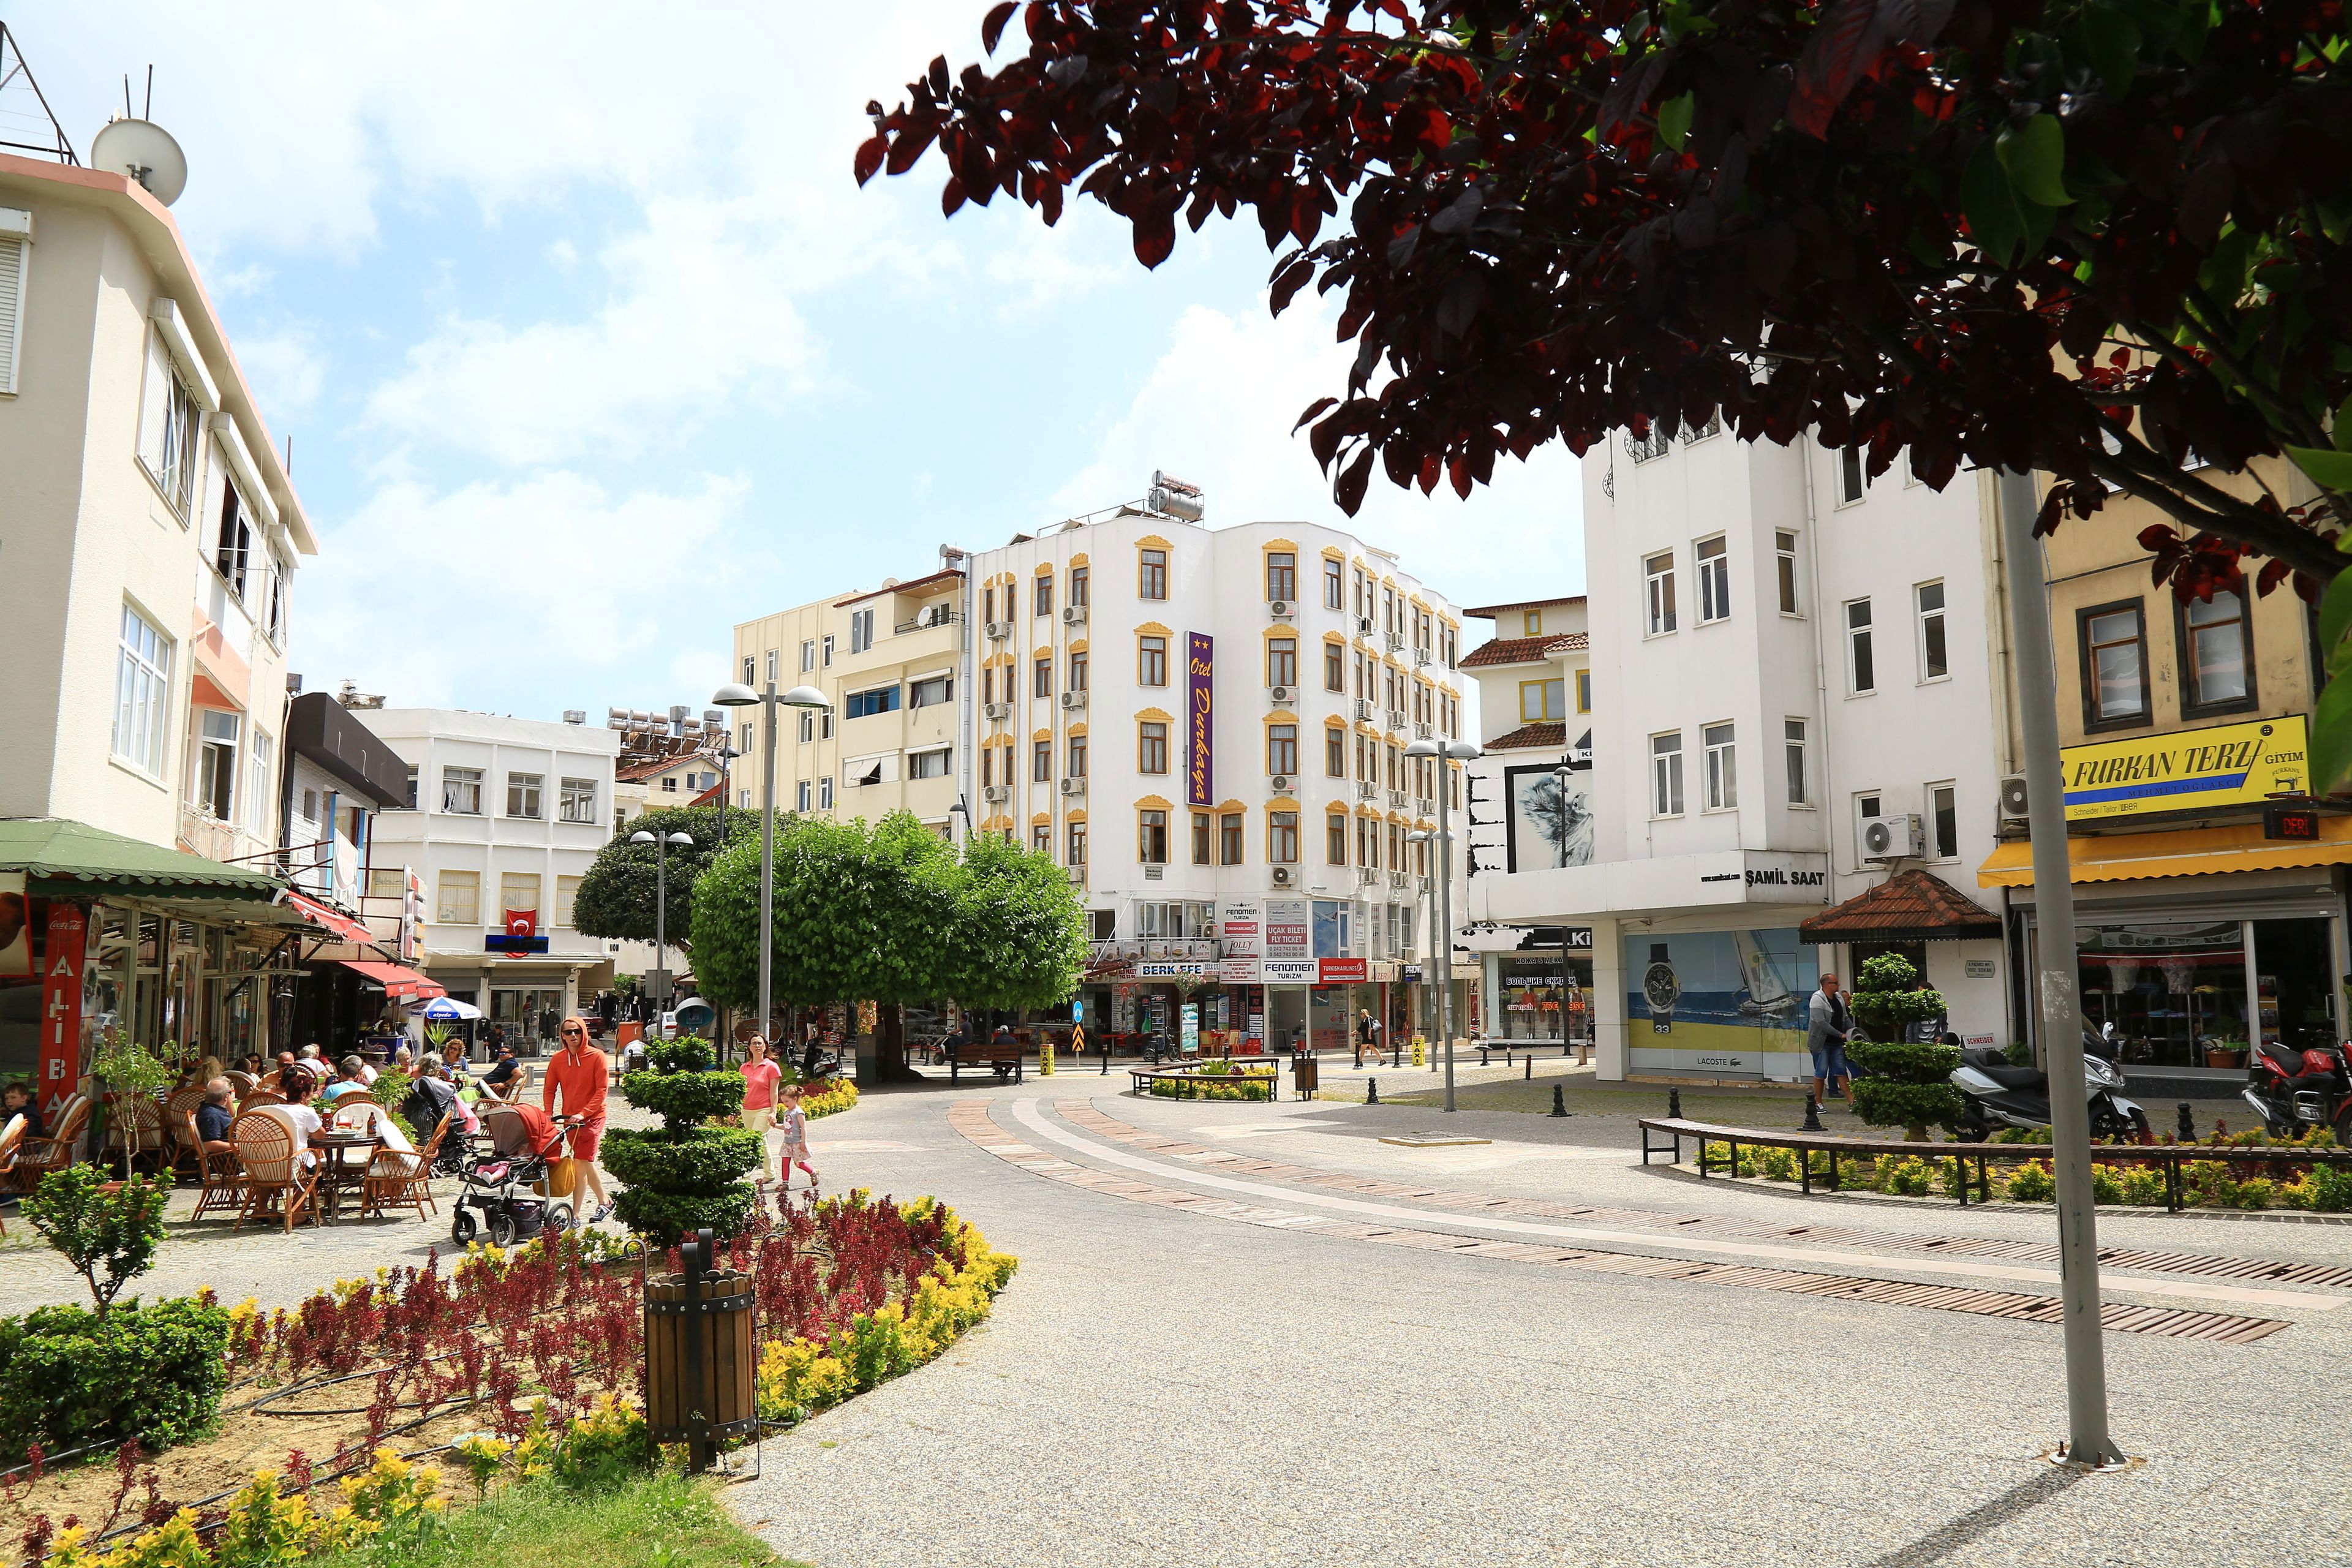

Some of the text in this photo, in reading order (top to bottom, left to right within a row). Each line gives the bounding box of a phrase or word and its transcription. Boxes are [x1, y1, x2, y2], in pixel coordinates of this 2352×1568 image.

[1190, 657, 1212, 677] Otel
[1192, 687, 1211, 802] Durkaya
[2264, 750, 2304, 764] GİYİM
[2073, 750, 2177, 787] FURKAN
[2272, 767, 2300, 776] FURKANS
[2128, 785, 2180, 797] MEHMET
[2073, 807, 2099, 816] Schneider
[2283, 816, 2310, 836] DERİ
[1746, 867, 1825, 887] ŞAMİL SAAT
[1268, 925, 1306, 935] UÇAK BİLETİ
[1142, 965, 1176, 975] BERK
[1180, 965, 1202, 974] EFE
[1265, 963, 1314, 972] FENOMEN
[1506, 977, 1542, 986] БОЛЬШИЕ
[1542, 1001, 1585, 1011] 75€ 95€
[1655, 1025, 1669, 1033] 33
[1967, 1036, 1994, 1045] SCHNEIDER
